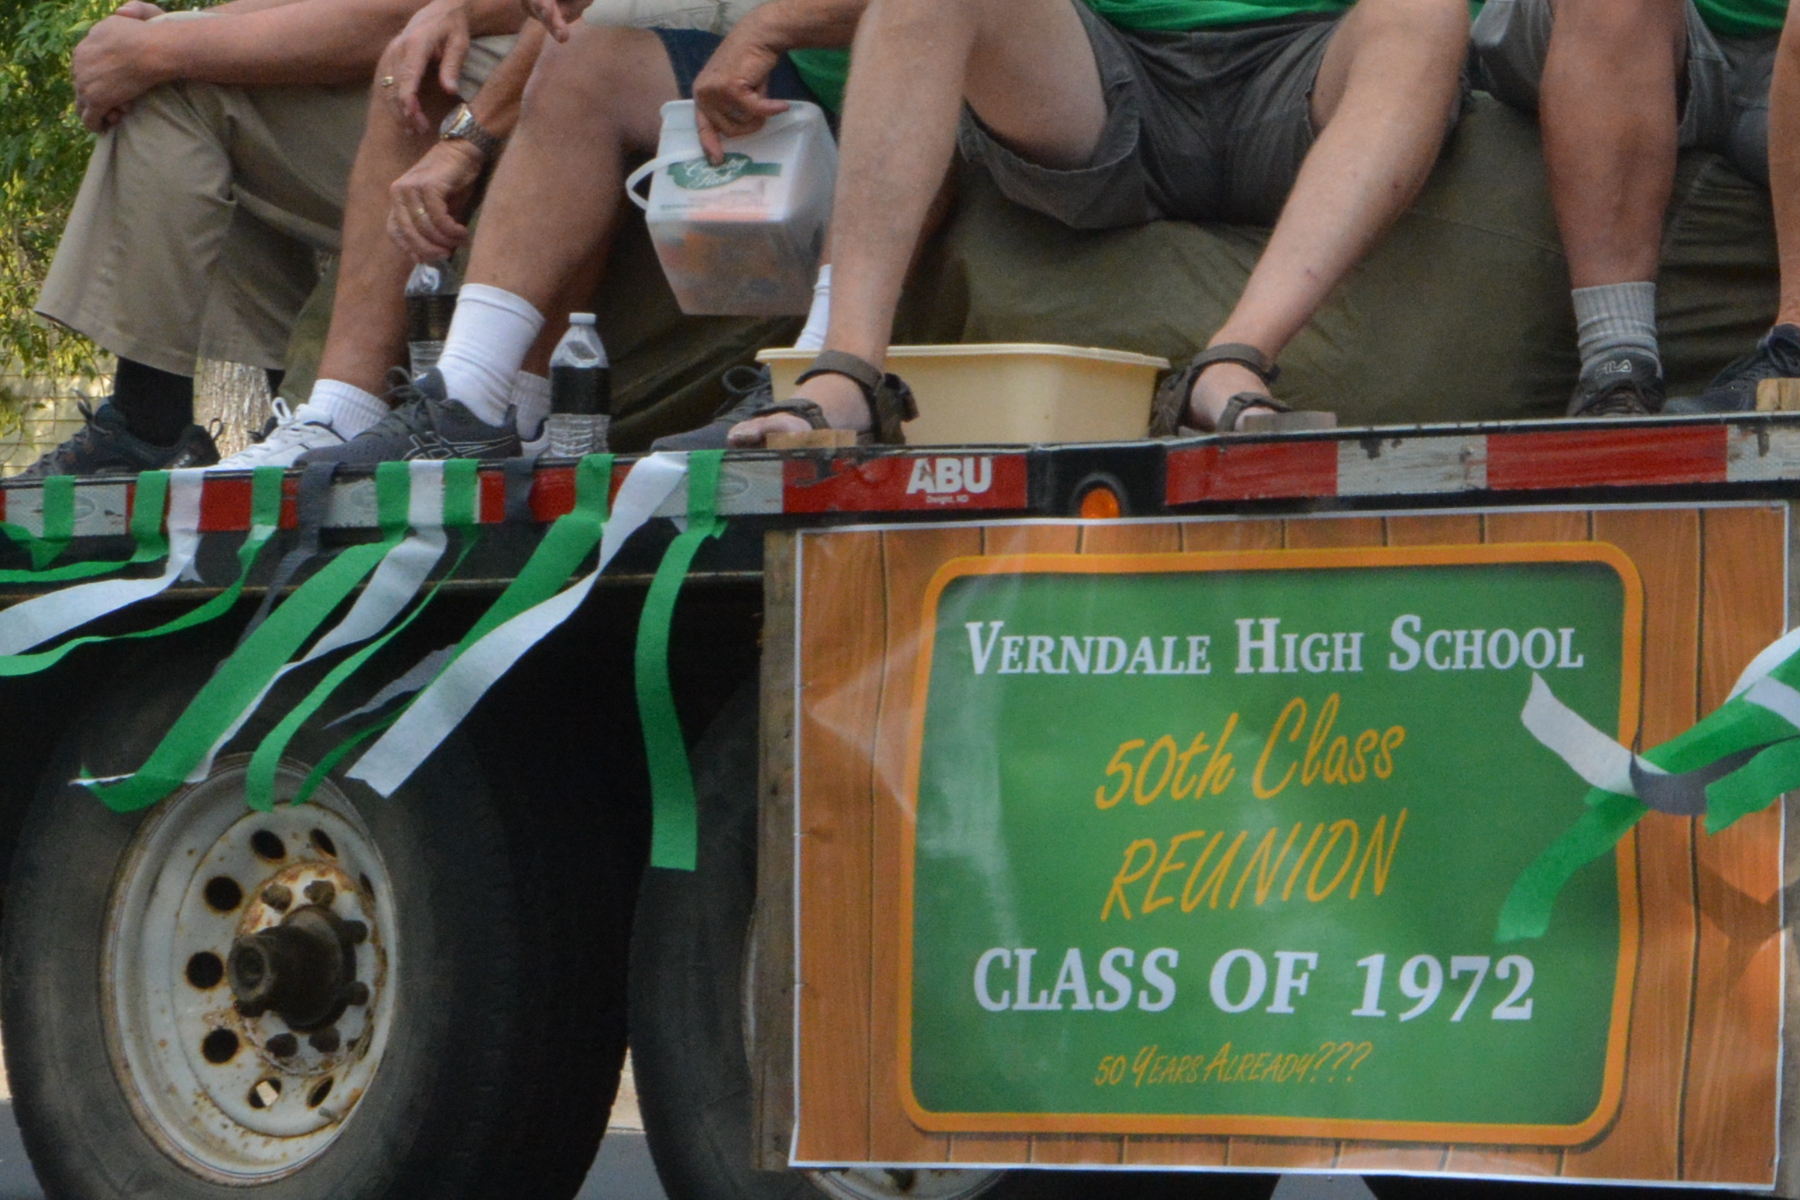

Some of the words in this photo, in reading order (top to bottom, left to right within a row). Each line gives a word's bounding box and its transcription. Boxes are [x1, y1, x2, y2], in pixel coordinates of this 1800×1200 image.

[906, 457, 992, 494] ABU
[965, 620, 1211, 675] VERNDALE
[1235, 618, 1364, 674] HIGH
[1389, 614, 1584, 672] SCHOOL
[1096, 712, 1239, 810] 50th
[1252, 692, 1406, 800] Class
[1101, 807, 1407, 921] REUNION
[973, 947, 1179, 1012] CLASS
[1210, 948, 1319, 1014] OF
[1351, 954, 1535, 1022] 1972
[1095, 1053, 1126, 1086] 50
